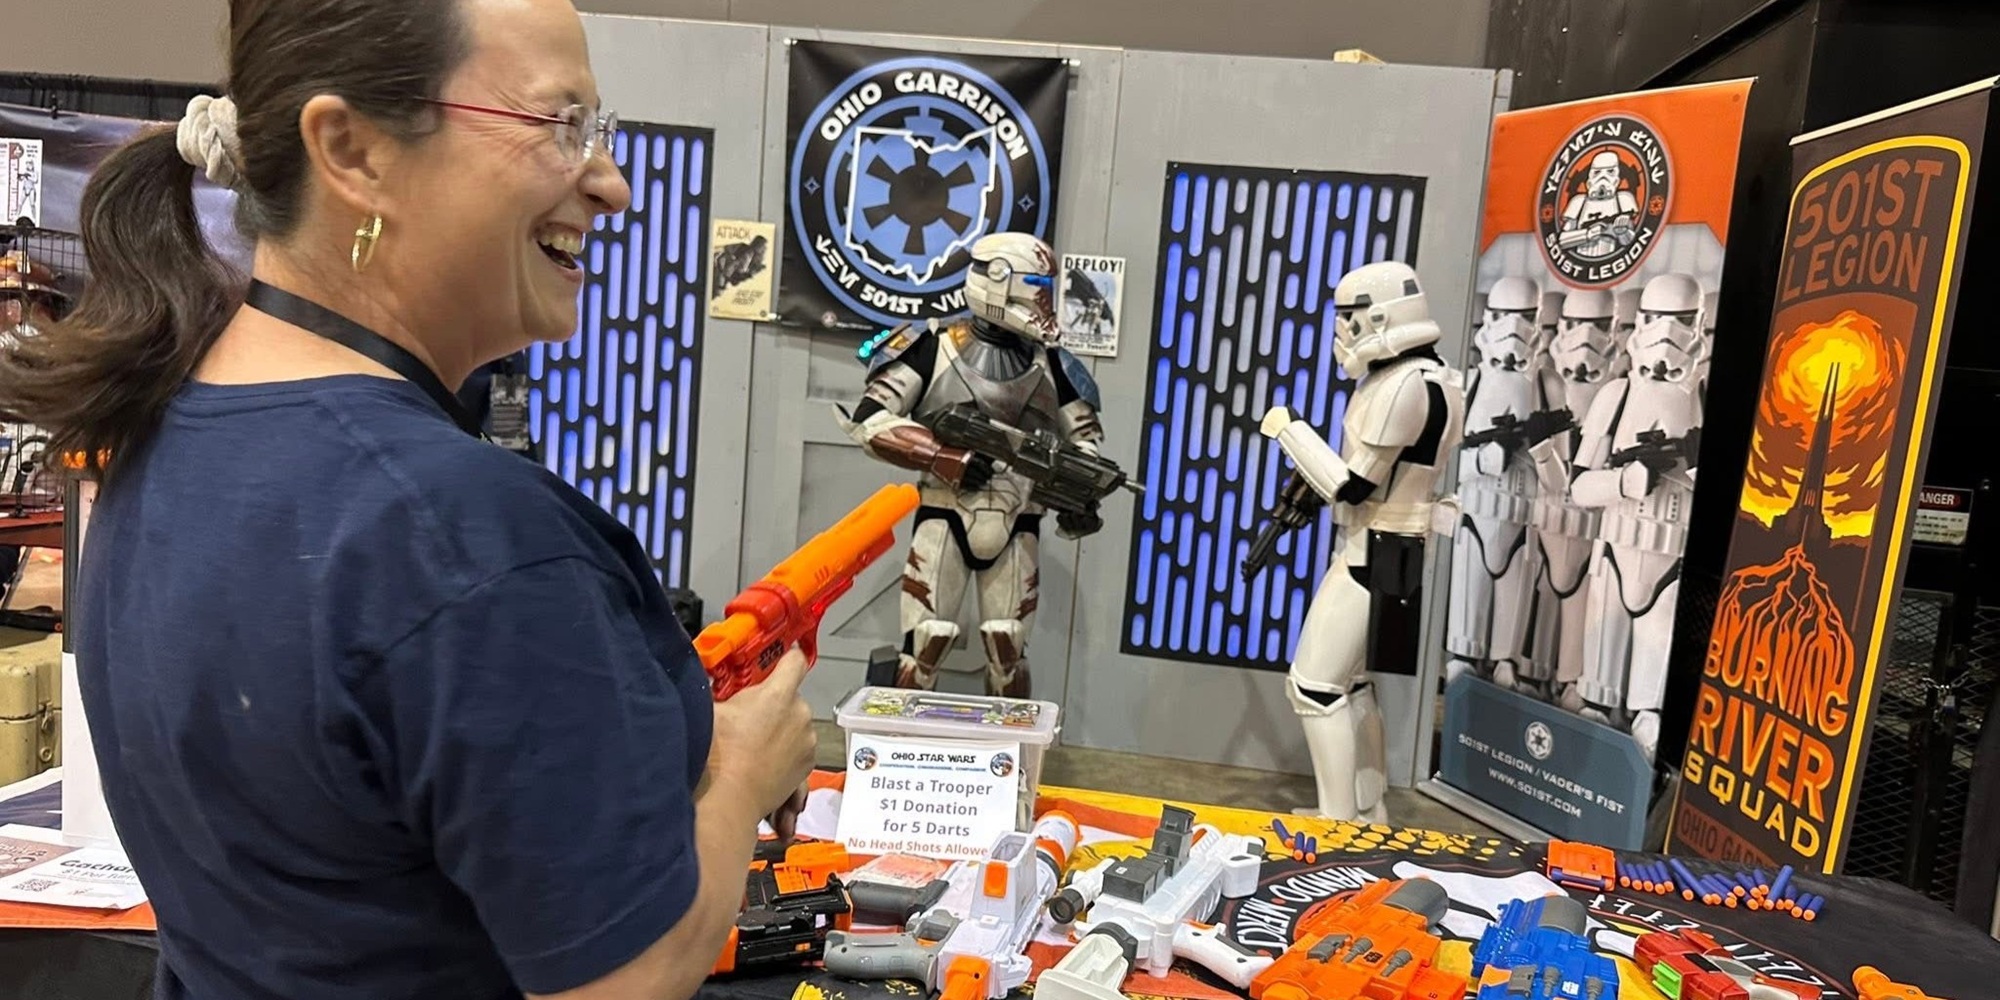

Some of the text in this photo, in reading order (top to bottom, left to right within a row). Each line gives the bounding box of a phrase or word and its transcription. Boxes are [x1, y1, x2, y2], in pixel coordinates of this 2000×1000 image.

[820, 71, 1029, 160] OHIO GARRISON
[1793, 158, 1944, 249] 501ST
[716, 226, 751, 239] ATTACK
[1065, 256, 1122, 273] DEPLOY!
[1545, 227, 1653, 280] 501ST LEGION
[1781, 229, 1928, 302] LEGION
[859, 286, 923, 314] 501ST
[1920, 492, 1955, 505] ANGER
[1703, 637, 1850, 737] BURNING
[891, 752, 977, 764] OHIO STAR WARS
[1690, 682, 1835, 823] RIVER
[871, 776, 993, 797] Blast a Trooper
[1458, 733, 1490, 755] 501ST
[1491, 748, 1534, 776] LEGION
[1542, 769, 1595, 801] VADER'S
[1596, 795, 1625, 815] FIST
[880, 798, 978, 816] $1 Donation
[1684, 750, 1821, 858] SQUAD
[848, 837, 988, 856] No Head Shots Allowe
[883, 819, 970, 837] for 5 Darts
[1680, 808, 1718, 854] OHIO
[1268, 866, 1380, 903] MANDO
